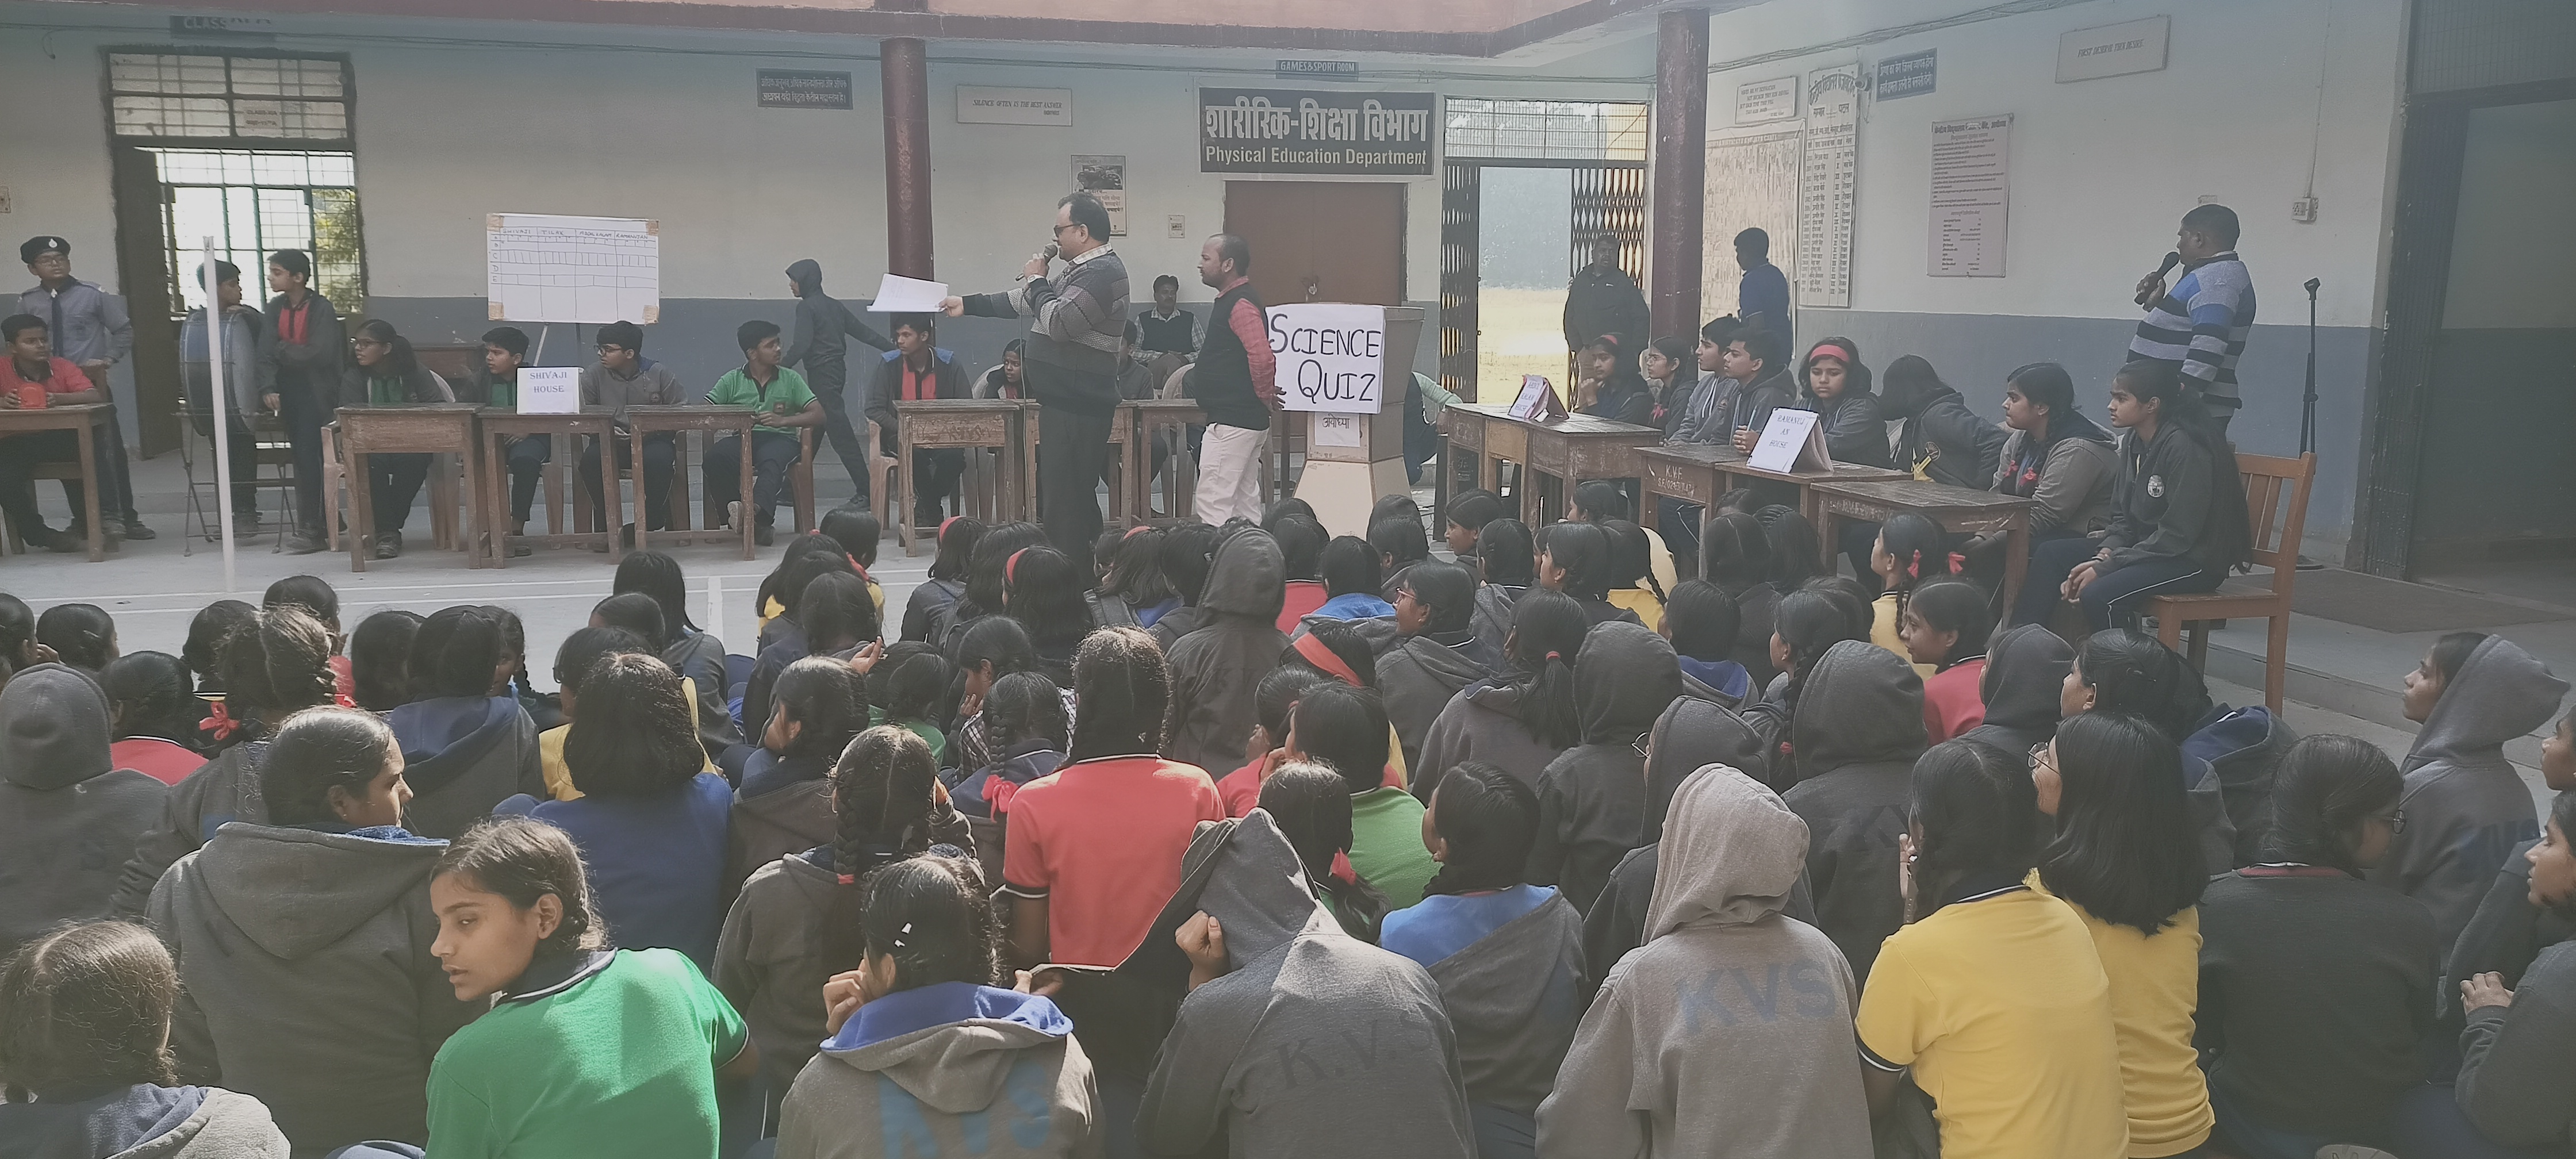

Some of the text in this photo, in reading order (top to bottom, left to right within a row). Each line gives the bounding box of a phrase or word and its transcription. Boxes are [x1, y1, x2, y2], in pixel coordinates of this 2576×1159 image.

[184, 16, 227, 29] CLASS
[1337, 62, 1355, 72] ROOM
[1205, 95, 1429, 142] शारीरिक-शिक्षा विभाग
[1206, 145, 1427, 168] Physical Education Department
[1268, 313, 1381, 358] SCIENCE
[530, 371, 568, 380] SHIVAJI
[1298, 359, 1376, 404] QUIZ
[1322, 413, 1351, 429] अयोध्या
[1677, 957, 1837, 1035] KVS
